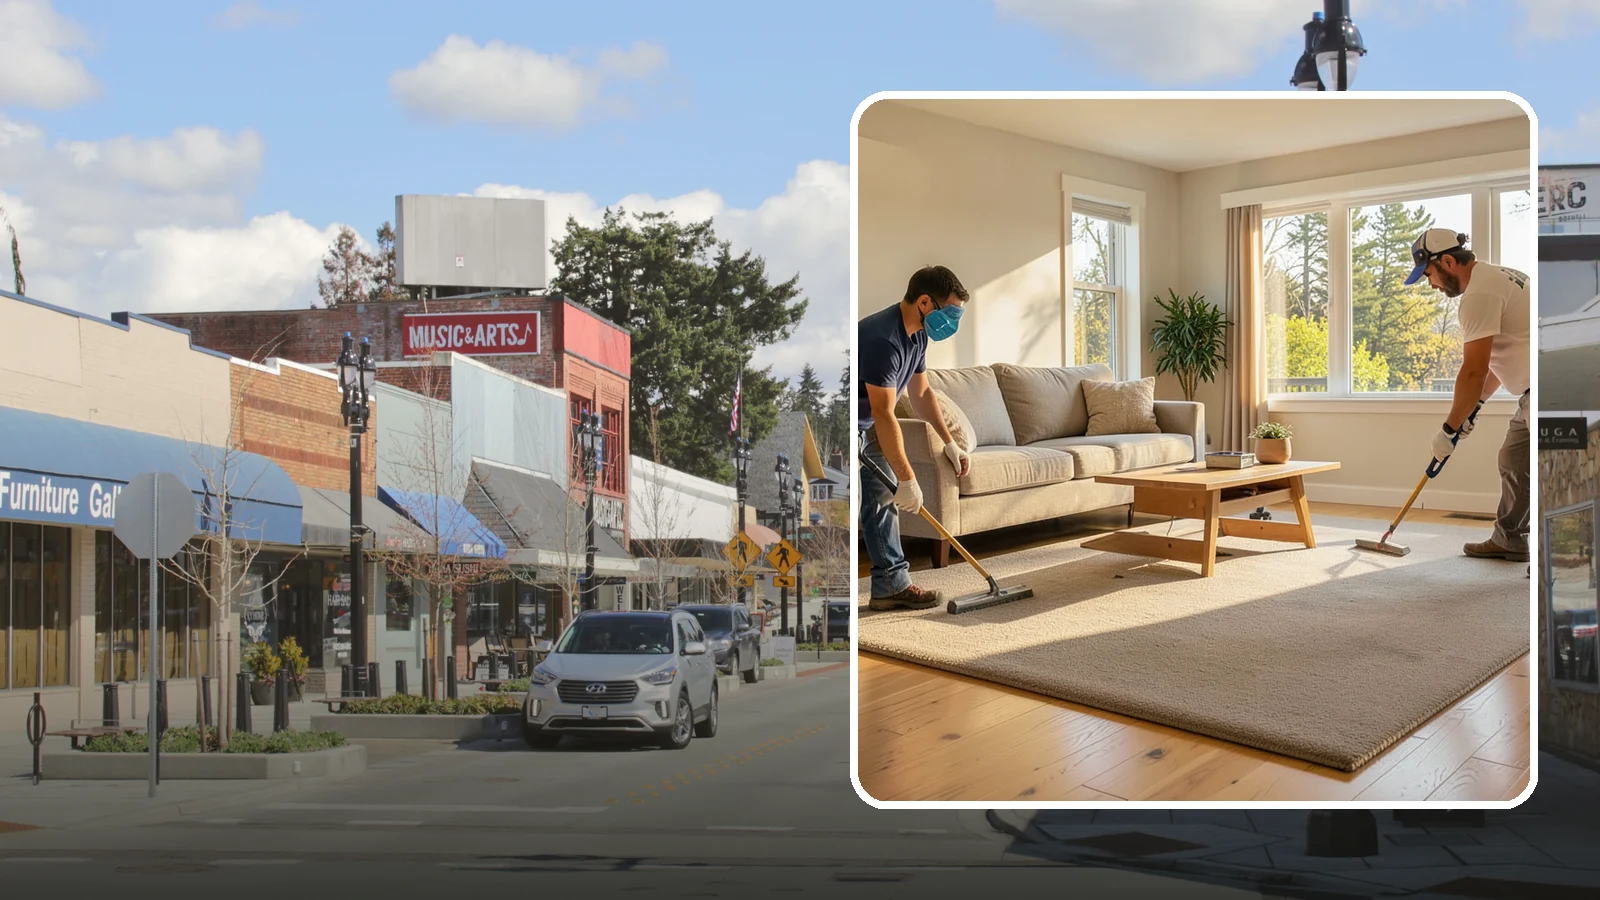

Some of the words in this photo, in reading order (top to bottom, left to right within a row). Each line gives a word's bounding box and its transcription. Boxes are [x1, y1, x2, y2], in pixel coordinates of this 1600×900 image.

[409, 323, 519, 348] MUSIC&ARTS
[0, 471, 79, 515] Furniture
[89, 482, 122, 519] Gal
